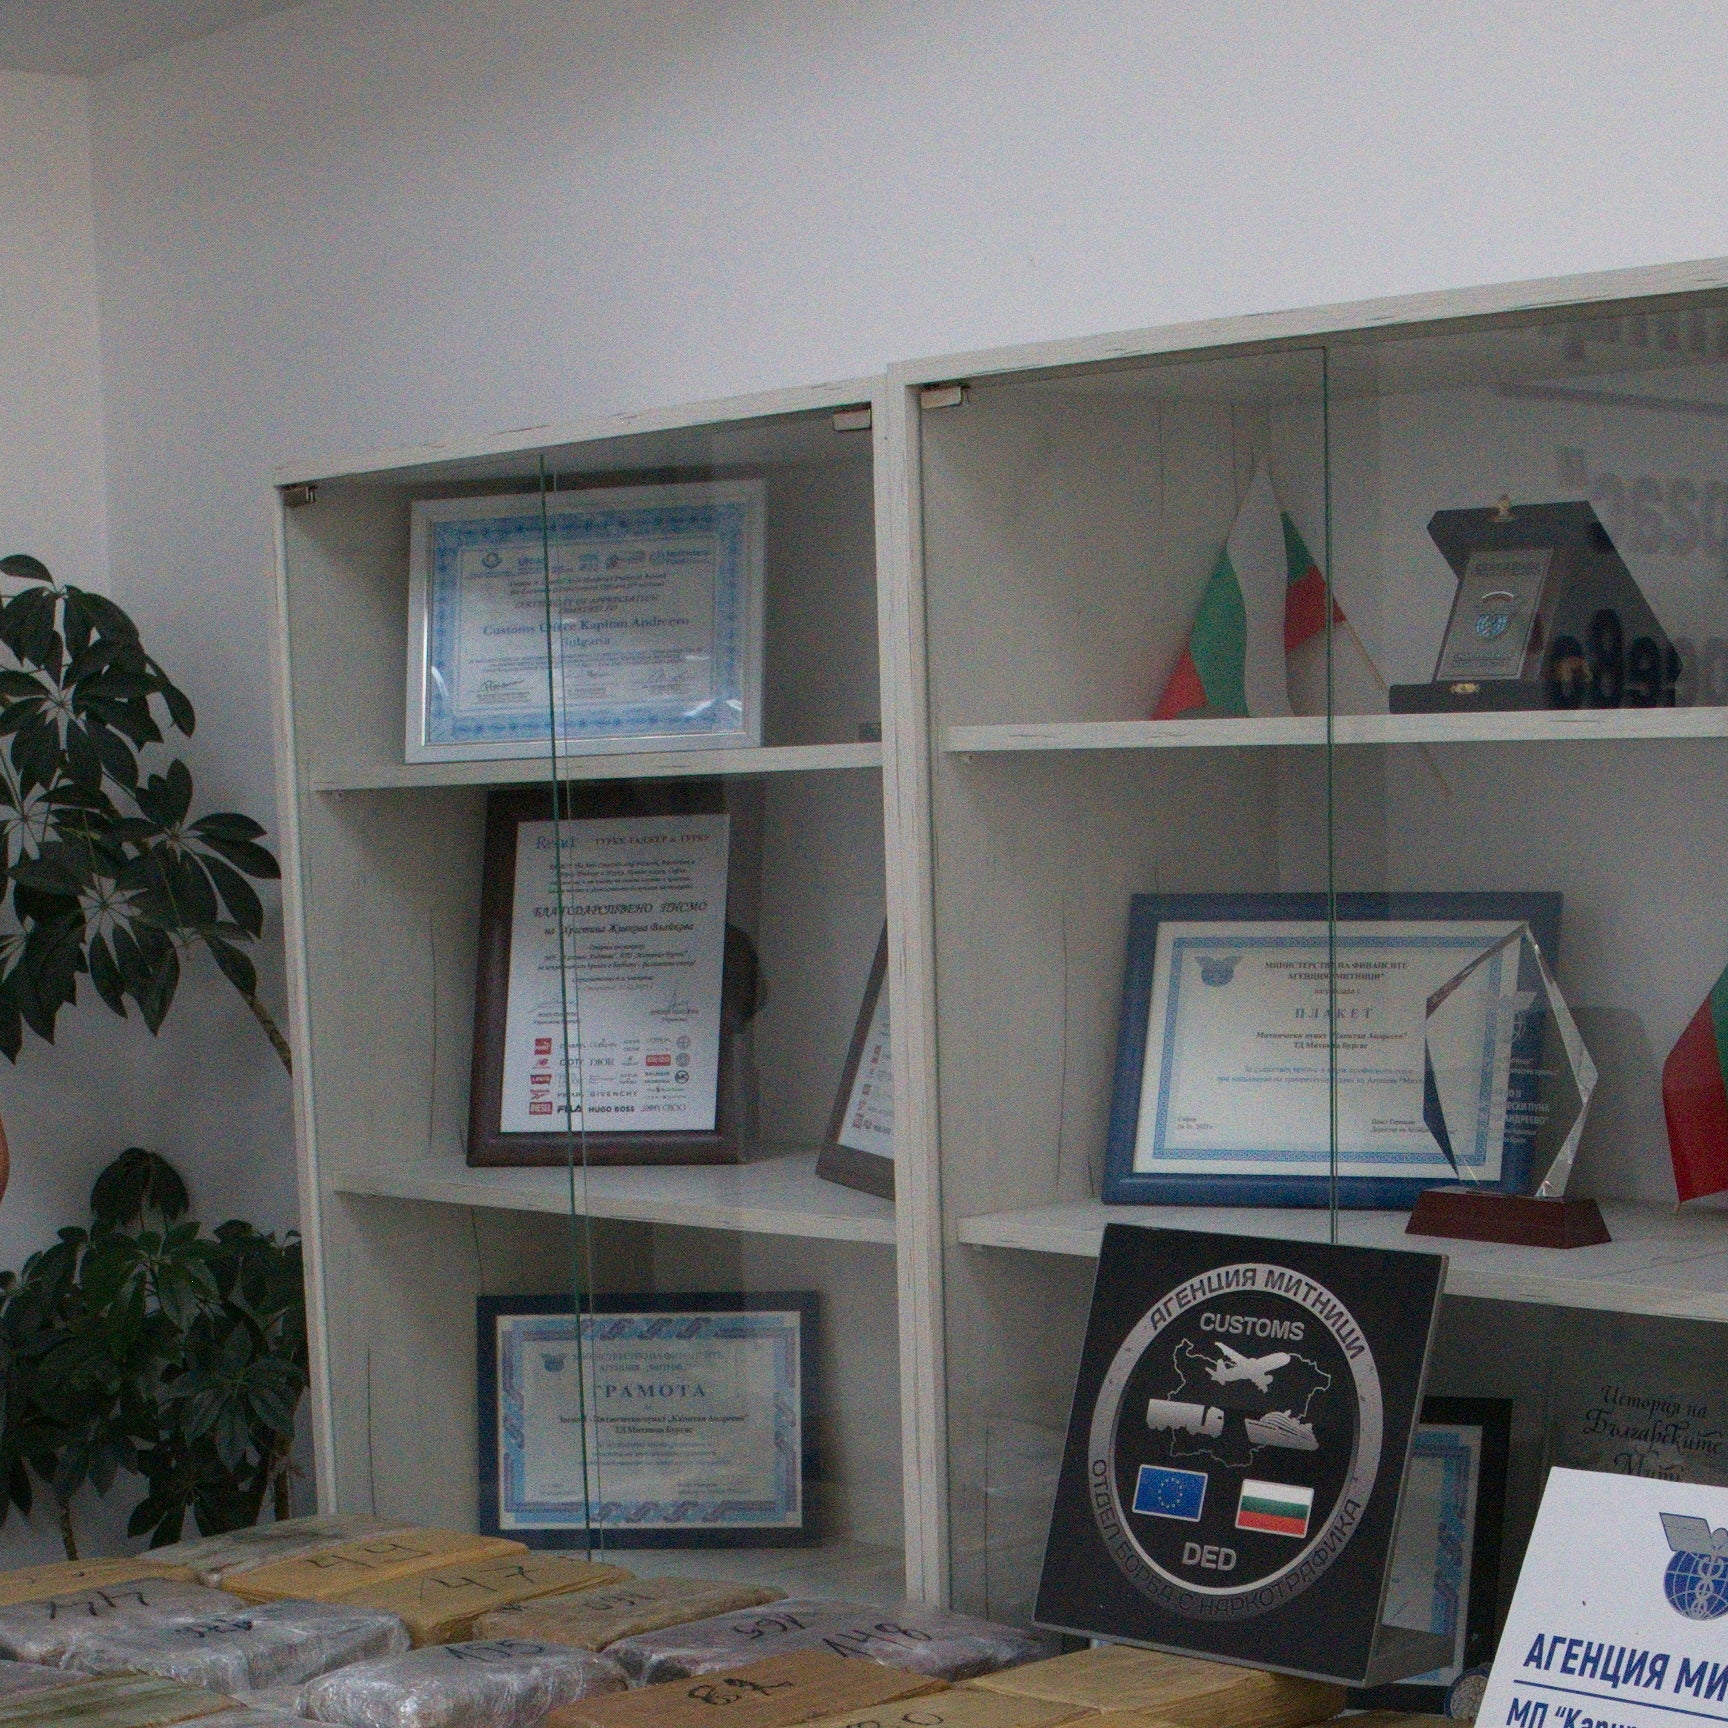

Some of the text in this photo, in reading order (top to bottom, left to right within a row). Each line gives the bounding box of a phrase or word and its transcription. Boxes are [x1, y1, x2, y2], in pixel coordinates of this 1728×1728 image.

[1149, 1268, 1366, 1360] АГЕНЦИЯ МИТНИЦИ
[1200, 1311, 1305, 1342] CUSTOMS
[1181, 1541, 1237, 1572] DED
[1523, 1632, 1669, 1691] АГЕНЦИЯ
